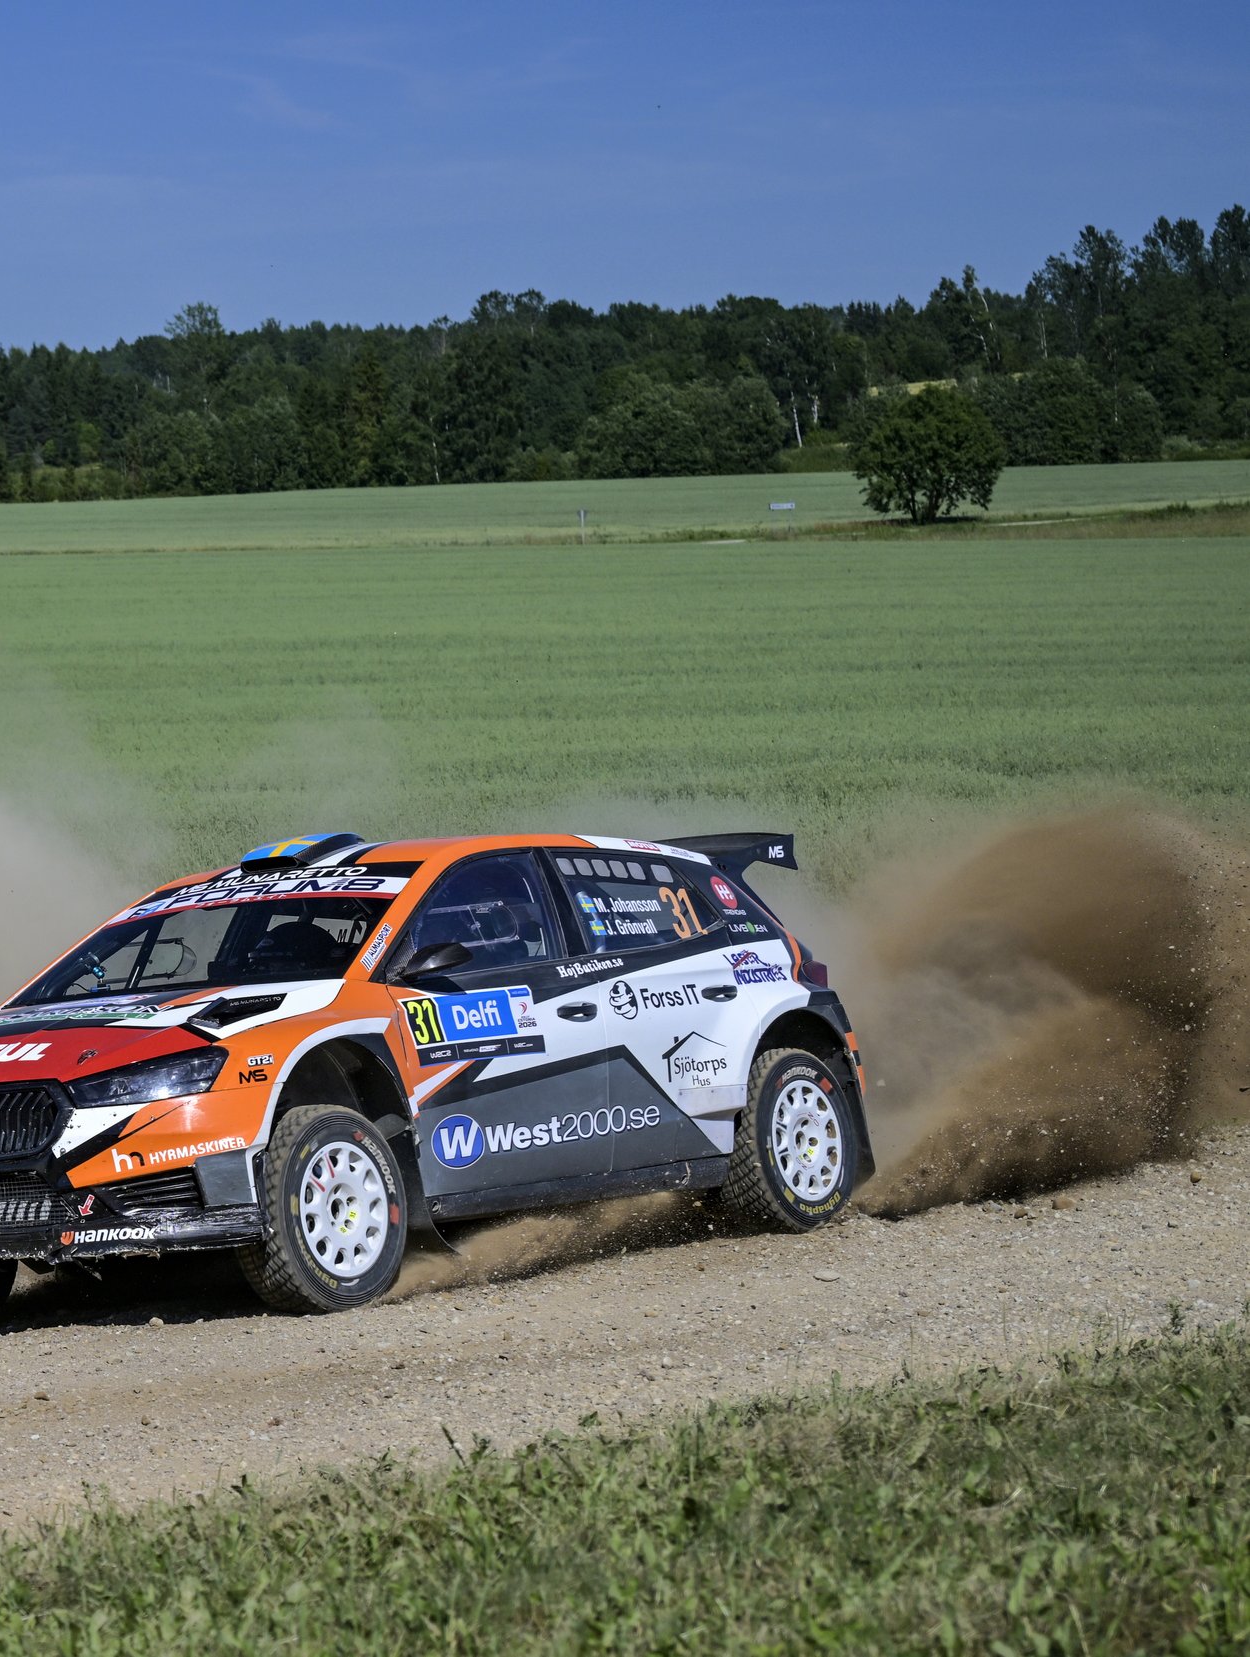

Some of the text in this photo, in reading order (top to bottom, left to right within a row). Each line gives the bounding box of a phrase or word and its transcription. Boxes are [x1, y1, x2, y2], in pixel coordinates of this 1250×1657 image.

[768, 845, 785, 859] MS
[164, 877, 386, 909] FORUM8
[174, 866, 368, 897] MS MUNARETTO
[593, 897, 662, 913] M. Johansson
[658, 886, 709, 939] 31
[606, 919, 658, 935] J. Grönvall
[369, 923, 393, 958] ALMASPORT
[733, 964, 788, 986] INDUSTRIES
[640, 983, 701, 1010] Forss IT
[406, 999, 502, 1044] 31 Delfi
[518, 1021, 537, 1029] 2026
[239, 1068, 268, 1085] MS
[673, 1056, 727, 1079] Sjötorps
[691, 1074, 711, 1087] Hus
[441, 1104, 661, 1159] W West2000.se
[149, 1136, 246, 1165] HYRMASKINER
[799, 1191, 841, 1216] Dynapro
